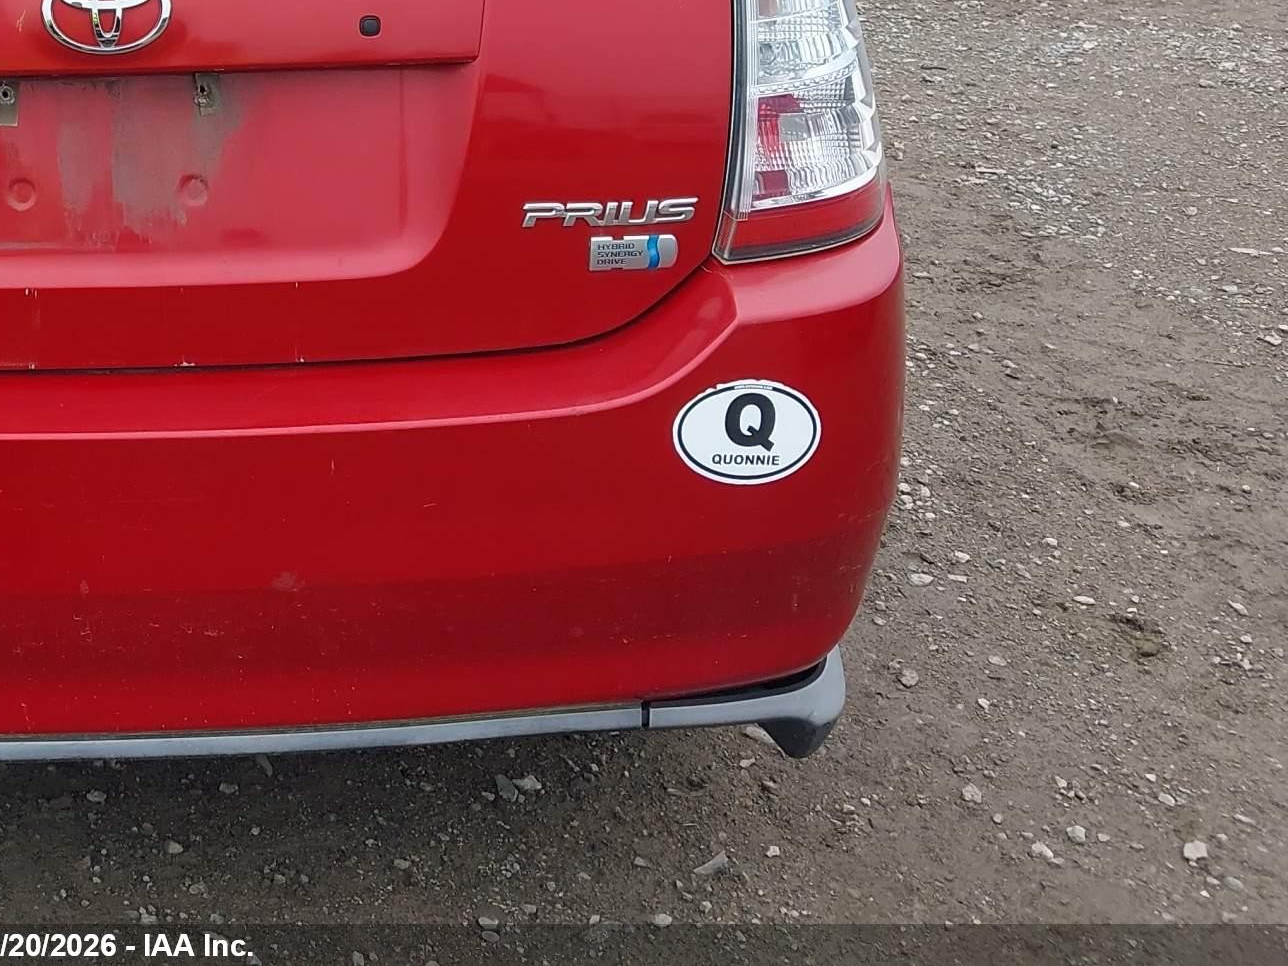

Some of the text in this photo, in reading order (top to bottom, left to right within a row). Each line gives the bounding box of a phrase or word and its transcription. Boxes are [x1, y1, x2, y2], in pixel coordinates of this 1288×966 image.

[522, 197, 699, 228] PRIUS
[597, 242, 635, 251] HYBRID
[597, 250, 644, 258] SYNERGY
[596, 258, 627, 266] DRIVE
[724, 392, 776, 452] Q
[712, 453, 781, 467] QUONNIE
